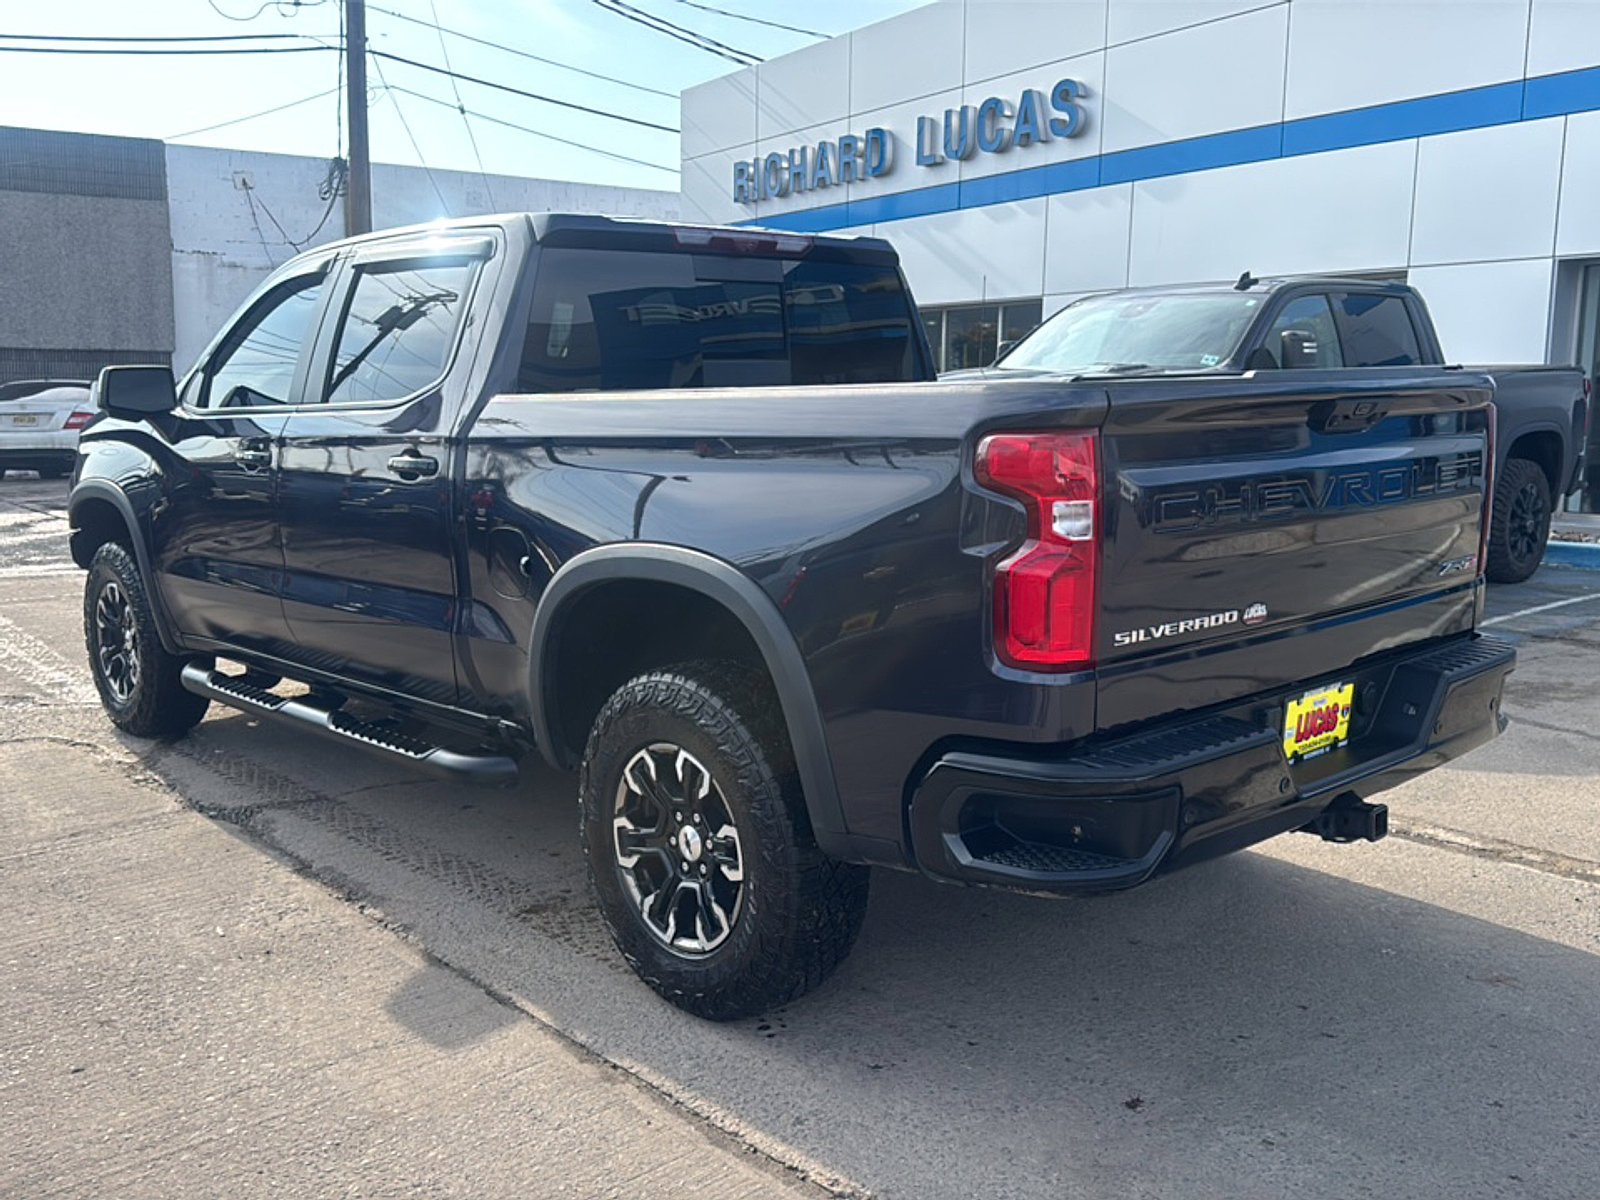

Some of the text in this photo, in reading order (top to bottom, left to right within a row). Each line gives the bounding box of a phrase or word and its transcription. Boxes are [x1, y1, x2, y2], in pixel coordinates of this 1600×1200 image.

[734, 78, 1092, 203] RICHARD LUCAS
[1152, 456, 1480, 534] CHEVROLET
[1113, 609, 1239, 647] SILVERADO
[1295, 703, 1339, 743] LUCAS
